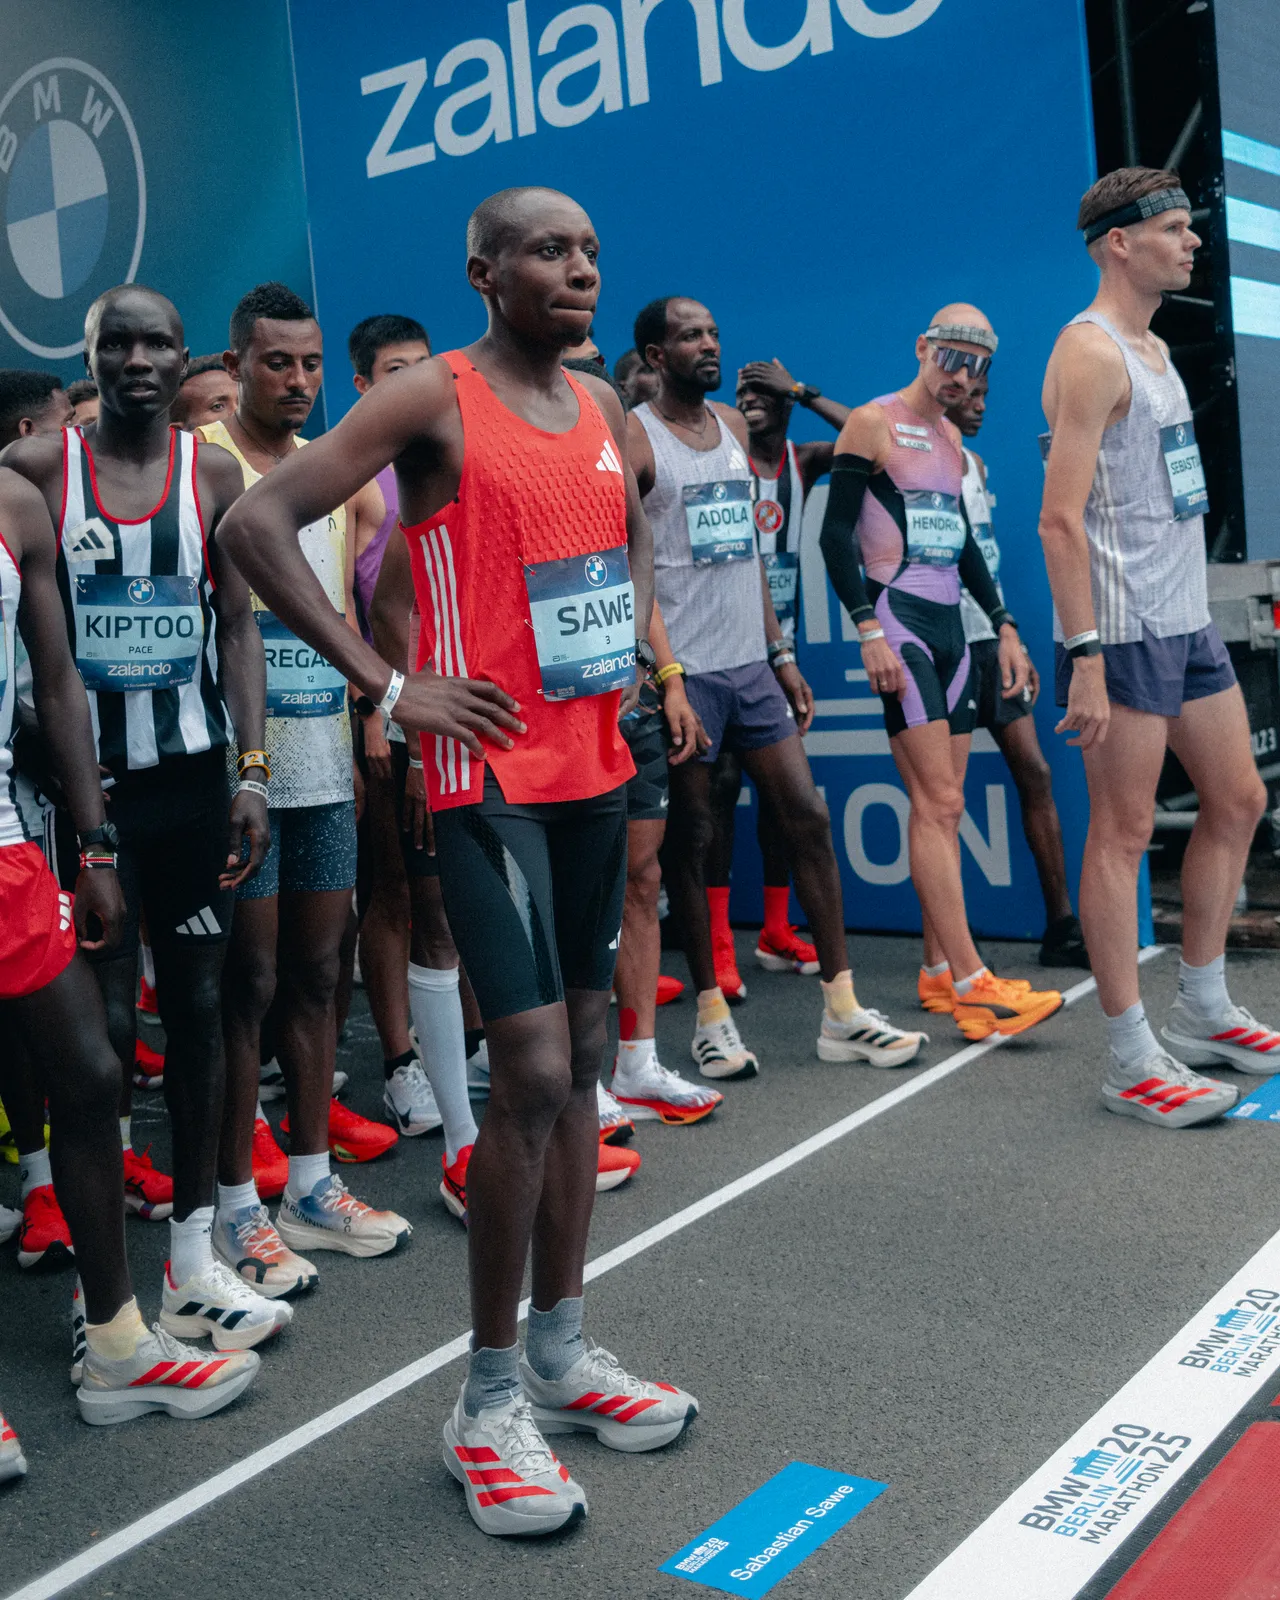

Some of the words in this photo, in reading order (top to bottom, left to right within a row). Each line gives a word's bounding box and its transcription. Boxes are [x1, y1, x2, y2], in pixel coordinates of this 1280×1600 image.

[360, 0, 941, 179] zalan
[0, 75, 117, 173] BMW
[696, 506, 749, 529] ADOLA
[85, 614, 194, 639] KIPTOO
[557, 592, 634, 637] SAWE
[128, 645, 153, 654] PACE
[605, 635, 611, 645] 3
[107, 662, 172, 677] zalando
[264, 648, 334, 669] REGA
[580, 651, 636, 679] zalando
[306, 675, 315, 683] 12
[281, 690, 333, 705] zalando
[815, 782, 1012, 886] ON
[1177, 1328, 1236, 1369] BMW
[1234, 1288, 1280, 1312] 20
[1209, 1333, 1260, 1373] BERLIN
[1017, 1475, 1091, 1532] BMW
[1096, 1423, 1152, 1455] 20
[1079, 1462, 1170, 1545] MARATHON
[1138, 1431, 1192, 1464] 25
[1052, 1483, 1118, 1538] BERLIN
[702, 1537, 720, 1548] 20
[713, 1540, 730, 1551] 25
[729, 1518, 815, 1581] Sabastian
[804, 1484, 855, 1518] Sawe
